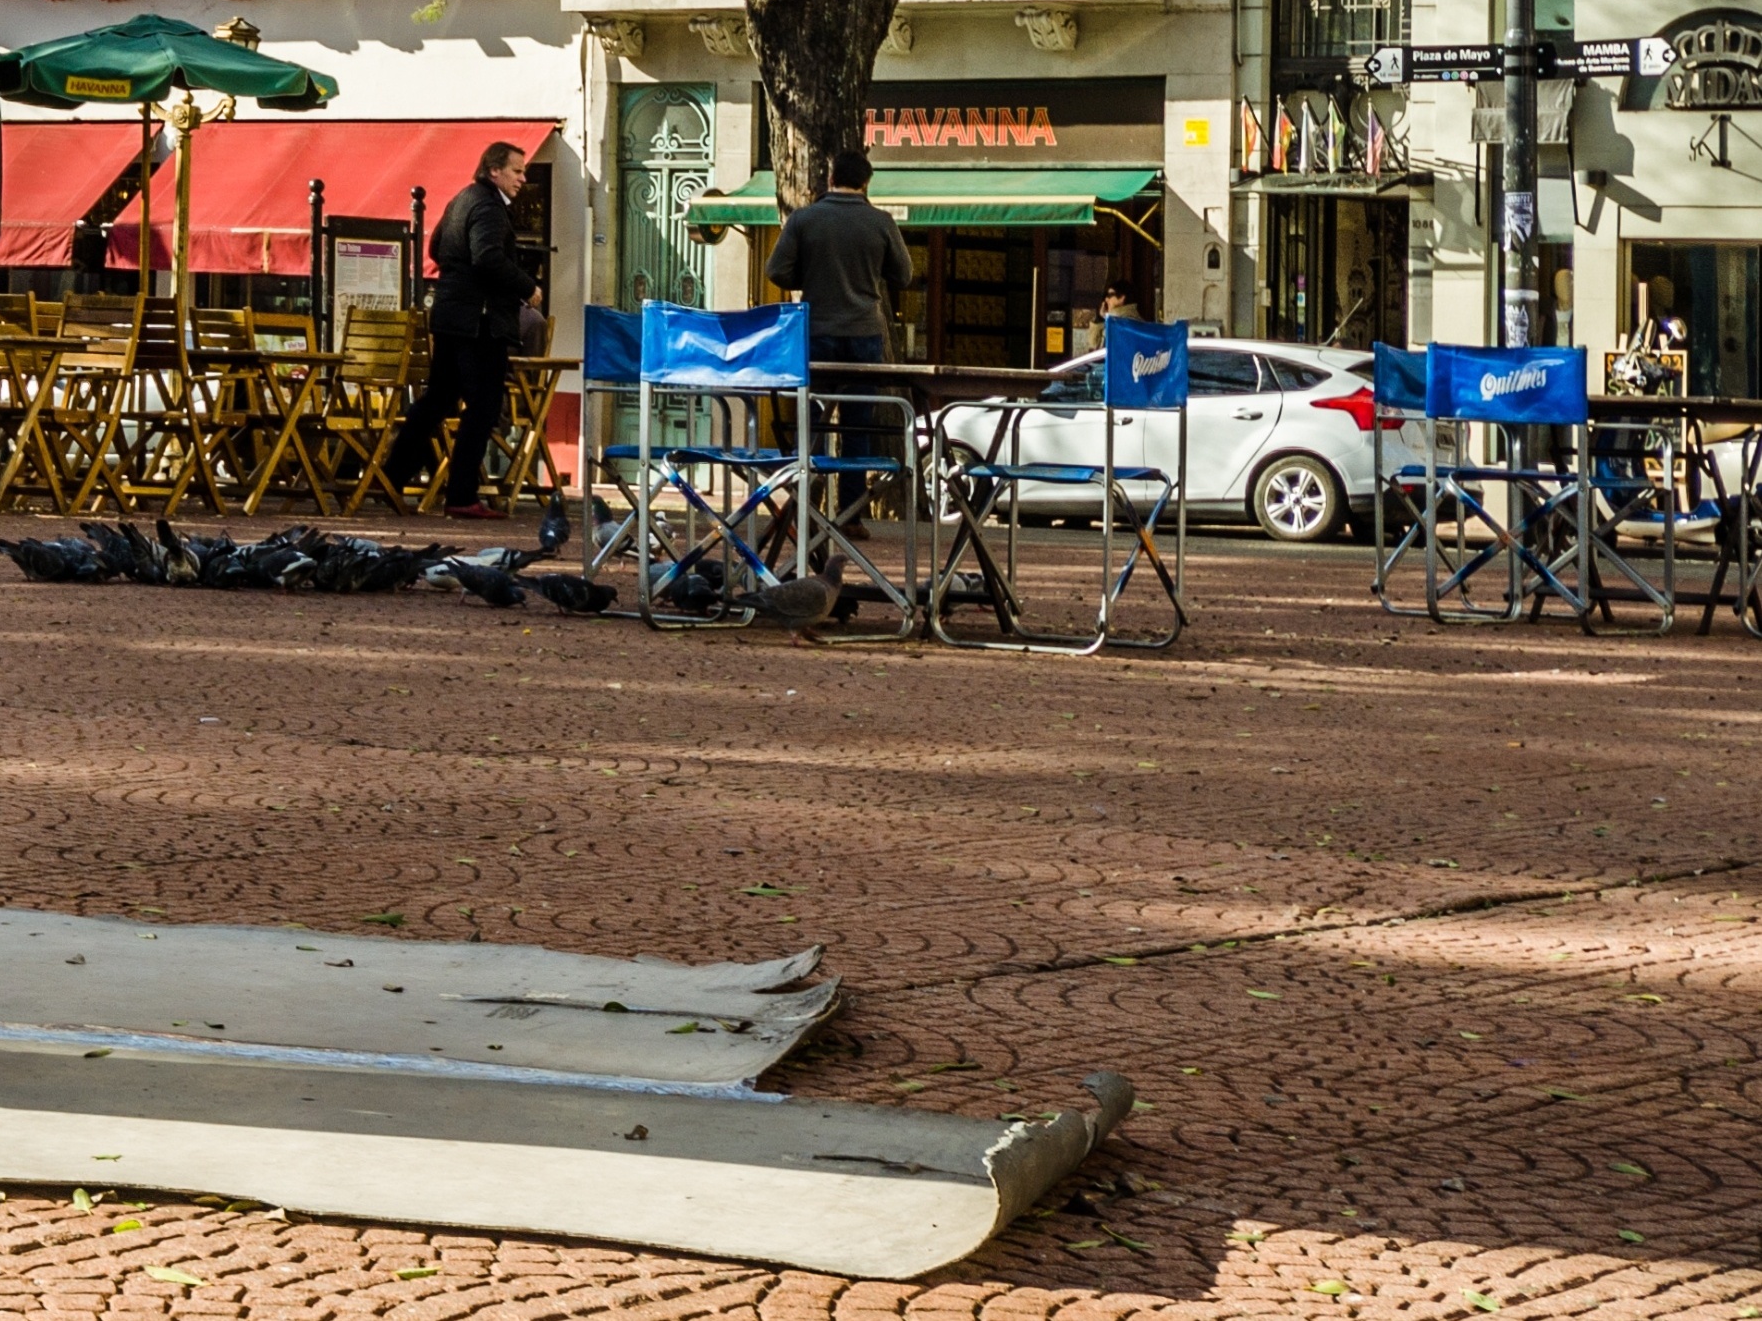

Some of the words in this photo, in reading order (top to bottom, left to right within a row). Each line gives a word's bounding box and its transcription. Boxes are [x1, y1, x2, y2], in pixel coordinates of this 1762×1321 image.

[1412, 50, 1442, 62] Plaza
[1443, 50, 1458, 61] de
[1459, 49, 1491, 62] Mayo
[1582, 43, 1630, 56] MAMBA
[69, 80, 127, 95] HAVANNA
[864, 107, 1058, 146] HAVANNA
[1479, 368, 1548, 402] Quilmes
